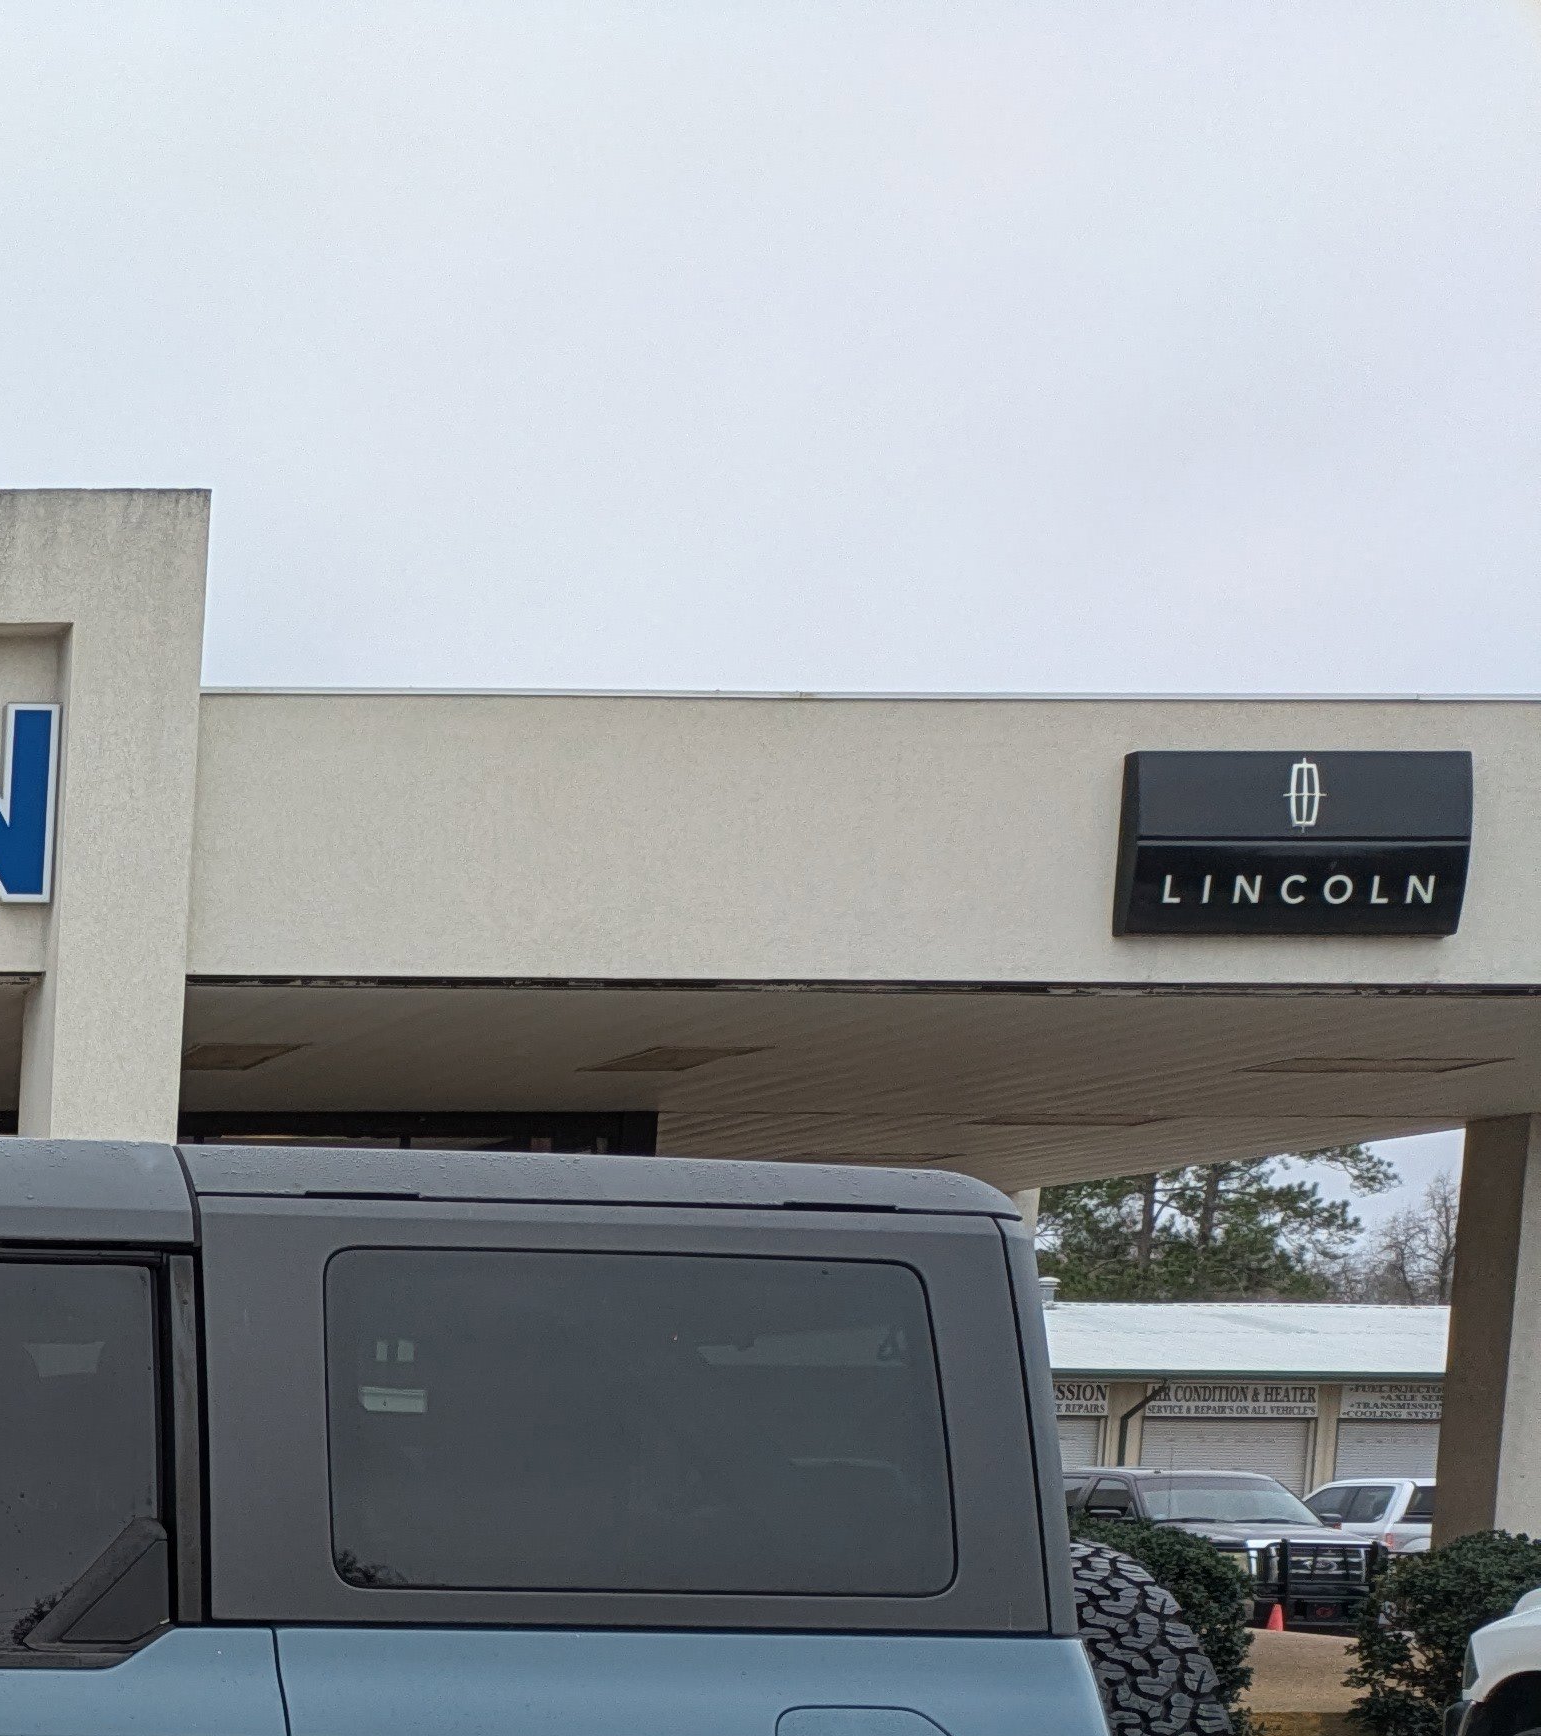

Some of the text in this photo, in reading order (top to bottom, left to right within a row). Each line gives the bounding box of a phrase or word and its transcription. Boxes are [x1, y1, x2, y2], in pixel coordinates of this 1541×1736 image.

[1162, 874, 1436, 904] LINCOLN
[1053, 1383, 1109, 1402] SSION
[1174, 1385, 1248, 1403] CONDITION
[1251, 1387, 1261, 1403] &
[1263, 1386, 1317, 1403] HEATER
[1064, 1403, 1106, 1413] REPAIRS
[1147, 1404, 1184, 1415] SERVICE
[1235, 1405, 1250, 1415] ON
[1251, 1405, 1268, 1415] ALL
[1346, 1410, 1403, 1418] COOLING
